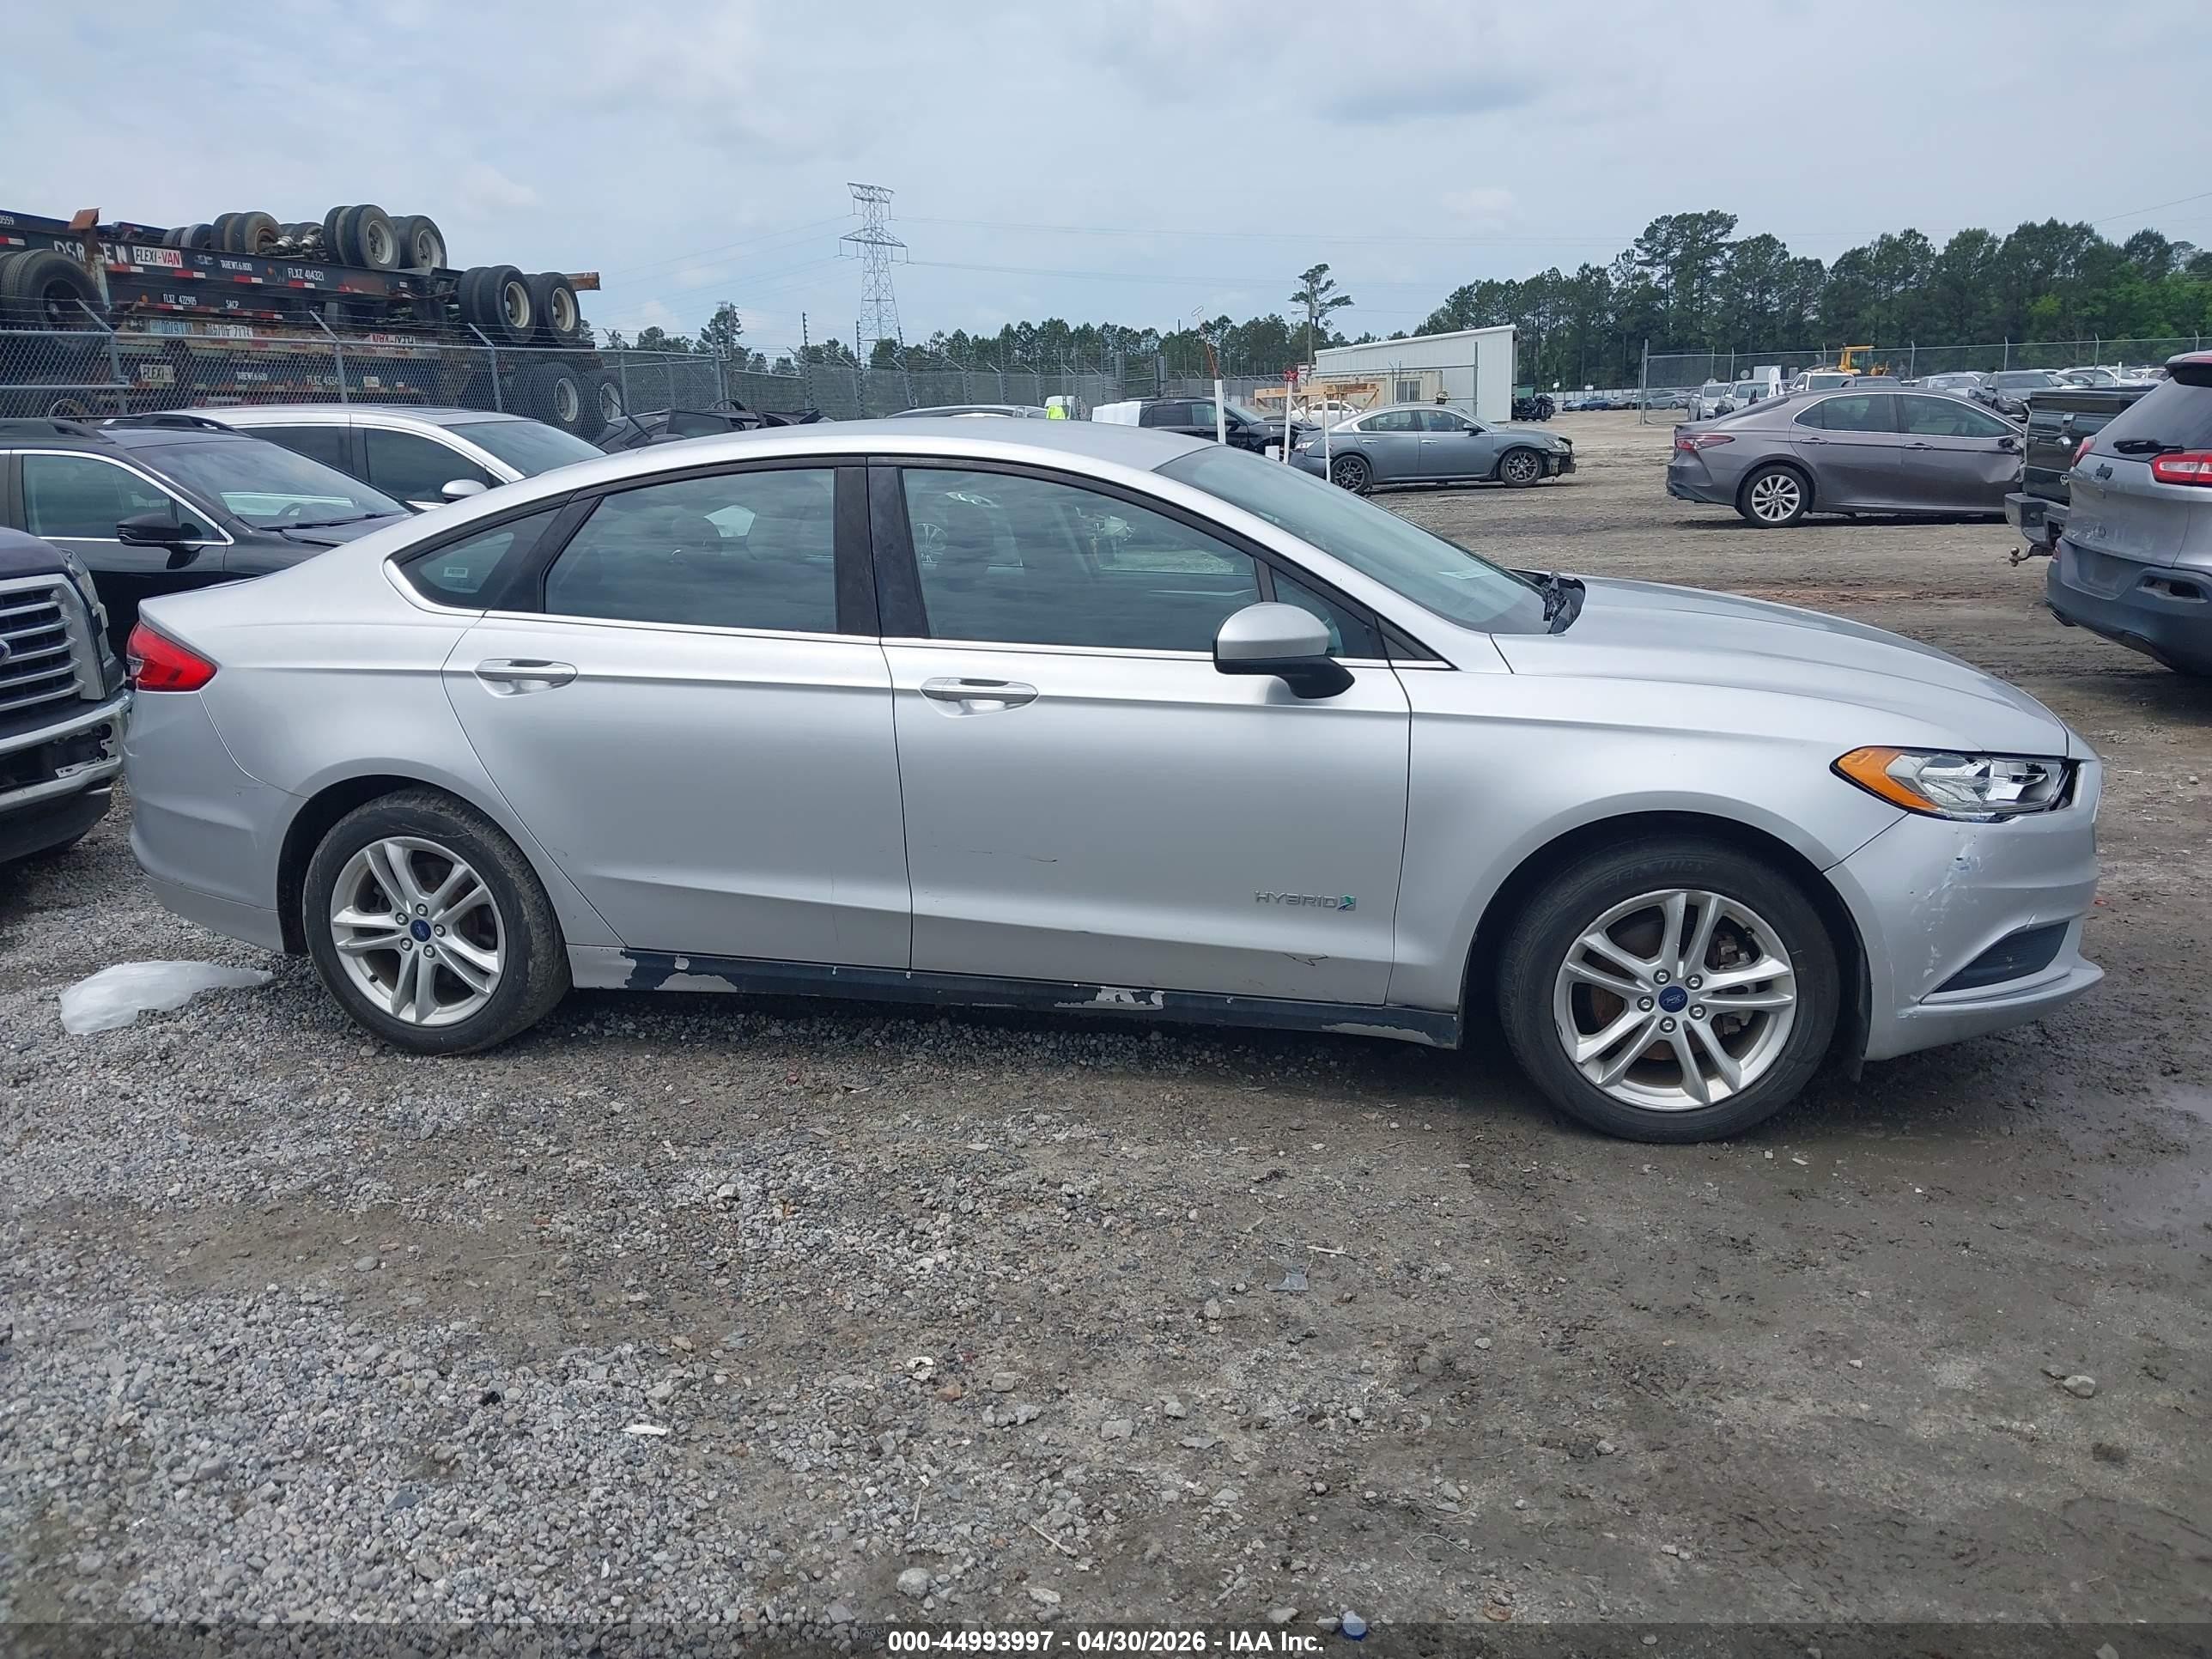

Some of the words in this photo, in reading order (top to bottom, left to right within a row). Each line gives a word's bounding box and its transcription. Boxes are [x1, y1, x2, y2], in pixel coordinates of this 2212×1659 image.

[135, 248, 180, 266] FLEXI-VAN
[288, 267, 303, 279] FLXZ
[1254, 890, 1338, 908] HYBRID
